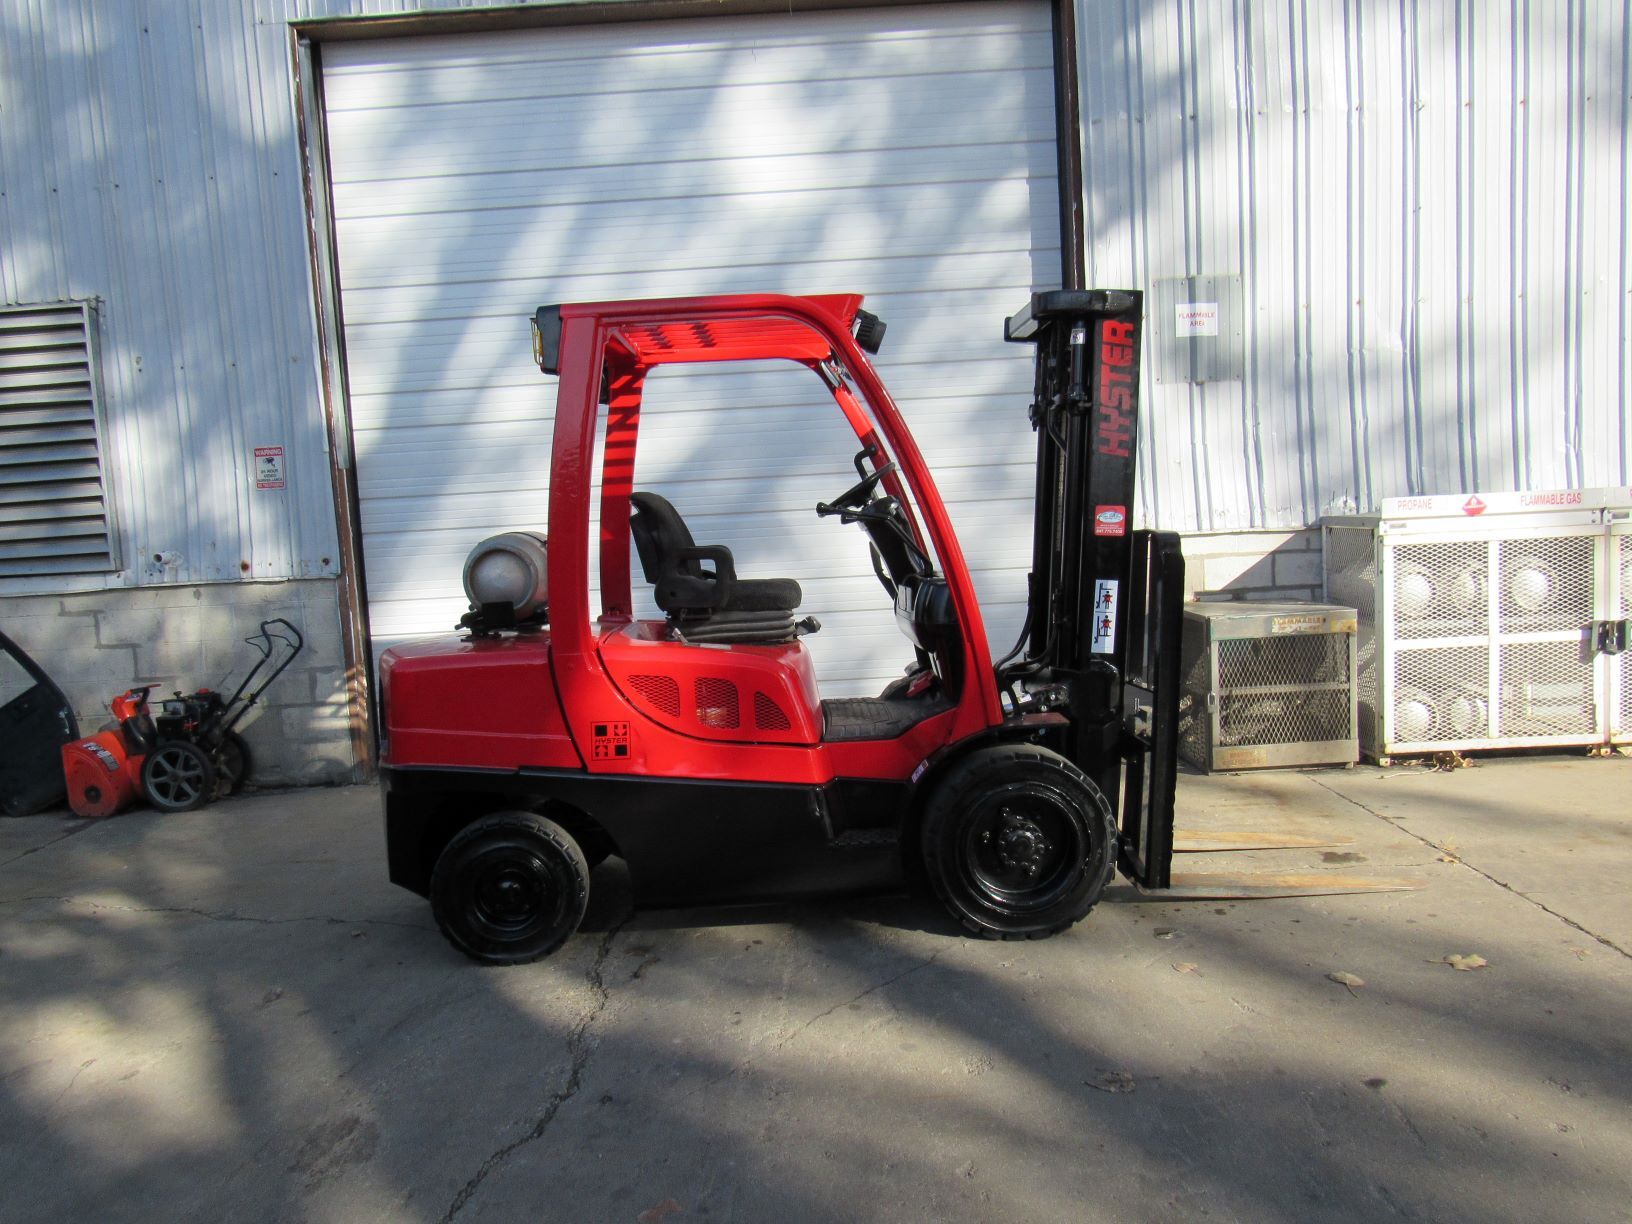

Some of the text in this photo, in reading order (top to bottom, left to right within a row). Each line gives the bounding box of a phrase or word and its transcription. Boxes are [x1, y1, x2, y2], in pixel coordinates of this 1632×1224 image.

[1098, 319, 1134, 457] HYSTER
[1397, 498, 1433, 511] PROPANE
[1520, 492, 1582, 506] FLAMMABLE GAS
